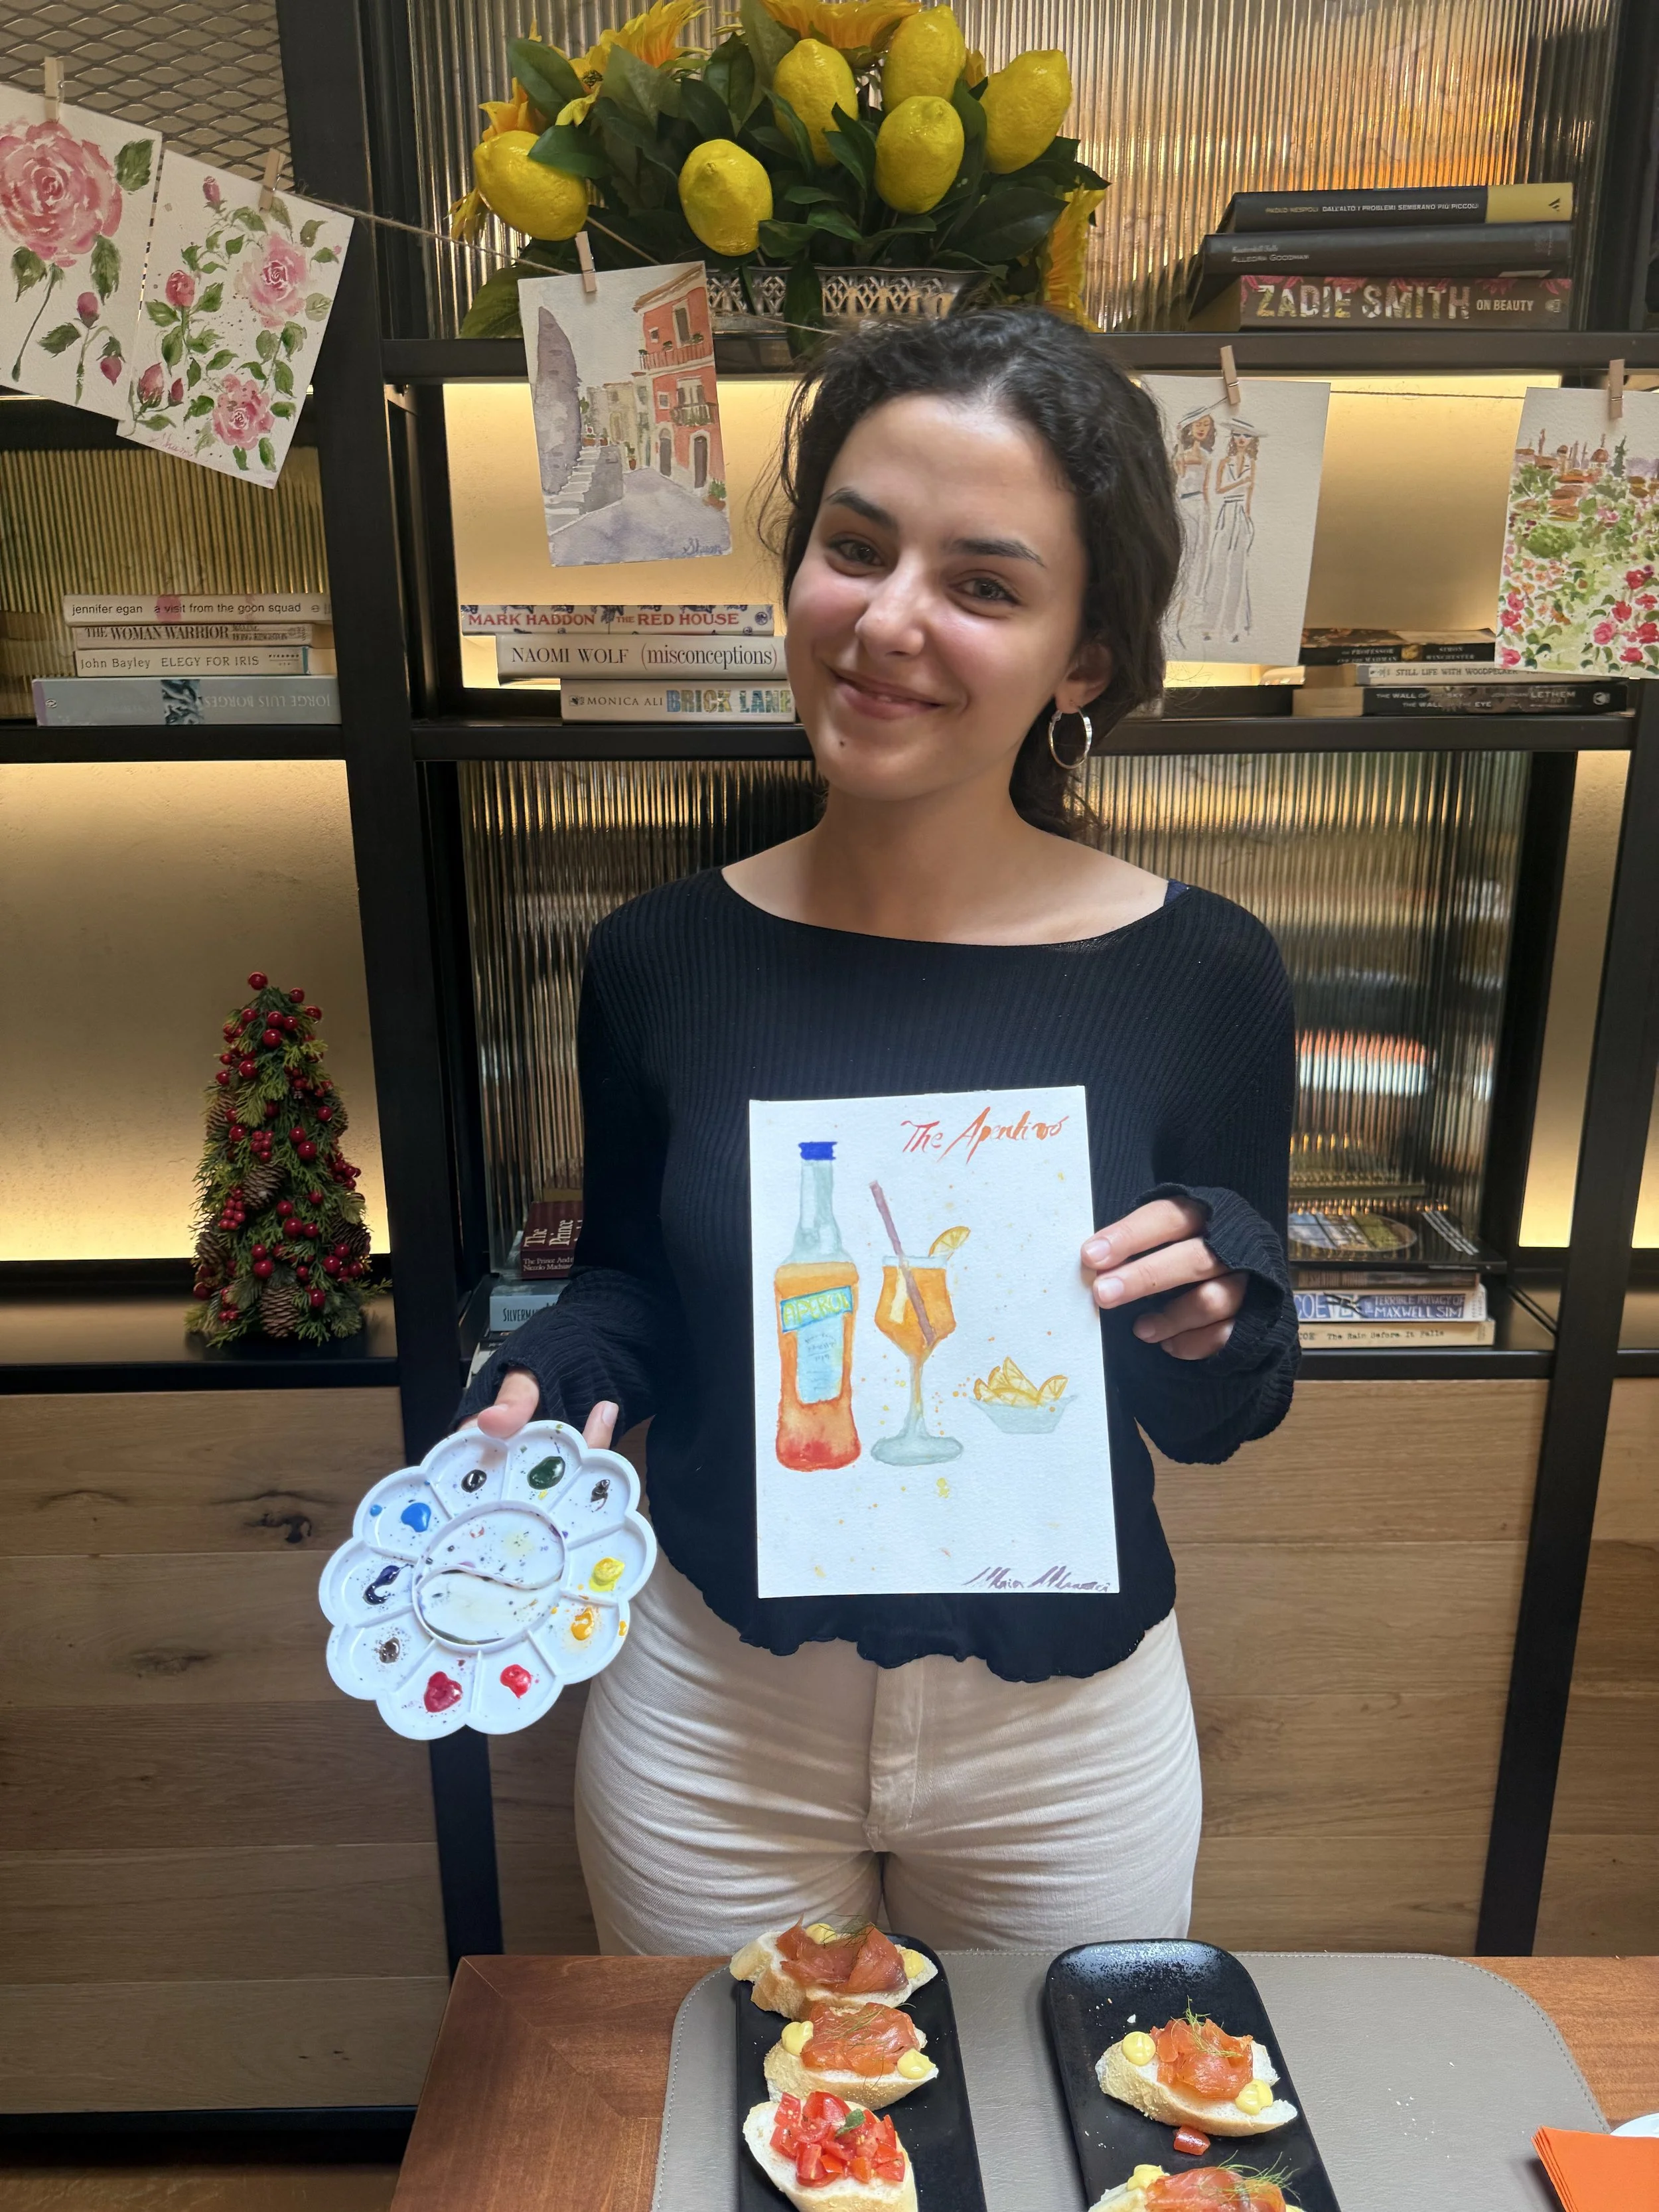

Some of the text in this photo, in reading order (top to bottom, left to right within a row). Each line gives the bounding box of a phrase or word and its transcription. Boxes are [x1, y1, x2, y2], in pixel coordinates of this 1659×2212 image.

[1256, 284, 1471, 320] ZADIE SMITH
[1476, 299, 1534, 312] ON BEAUTY
[72, 604, 143, 617] jennifer egan
[164, 605, 185, 613] visit
[189, 603, 214, 613] from
[217, 603, 234, 612] the
[238, 605, 265, 614] goon
[268, 603, 301, 614] squad
[468, 613, 596, 626] MARK HADDON
[616, 613, 740, 626] THE RED HOUSE
[84, 626, 108, 638] THE
[110, 626, 163, 640] WOMAN
[164, 625, 229, 640] WARRIOR
[161, 656, 200, 667] ELEGY
[206, 656, 230, 666] FOR
[235, 655, 259, 666] IRIS
[511, 646, 629, 664] NAOMI WOLF
[641, 642, 778, 671] (misconceptions)
[80, 656, 151, 670] John Bayley
[1395, 668, 1419, 676] STILL
[205, 694, 331, 708] JORGE LUIS BORGES
[666, 689, 792, 713] BRICK LANE
[1530, 690, 1576, 699] LETHEM
[587, 697, 639, 706] MONICA
[644, 697, 663, 706] ALI
[900, 1120, 944, 1153] The
[523, 1228, 548, 1247] The
[1375, 1293, 1465, 1306] TERRIBLE PRIVACY OF
[1374, 1305, 1433, 1318] MAXWELL
[1435, 1304, 1463, 1318] SIM
[1347, 1331, 1367, 1340] Rain
[1370, 1331, 1400, 1339] Before
[1419, 1329, 1444, 1338] Falls
